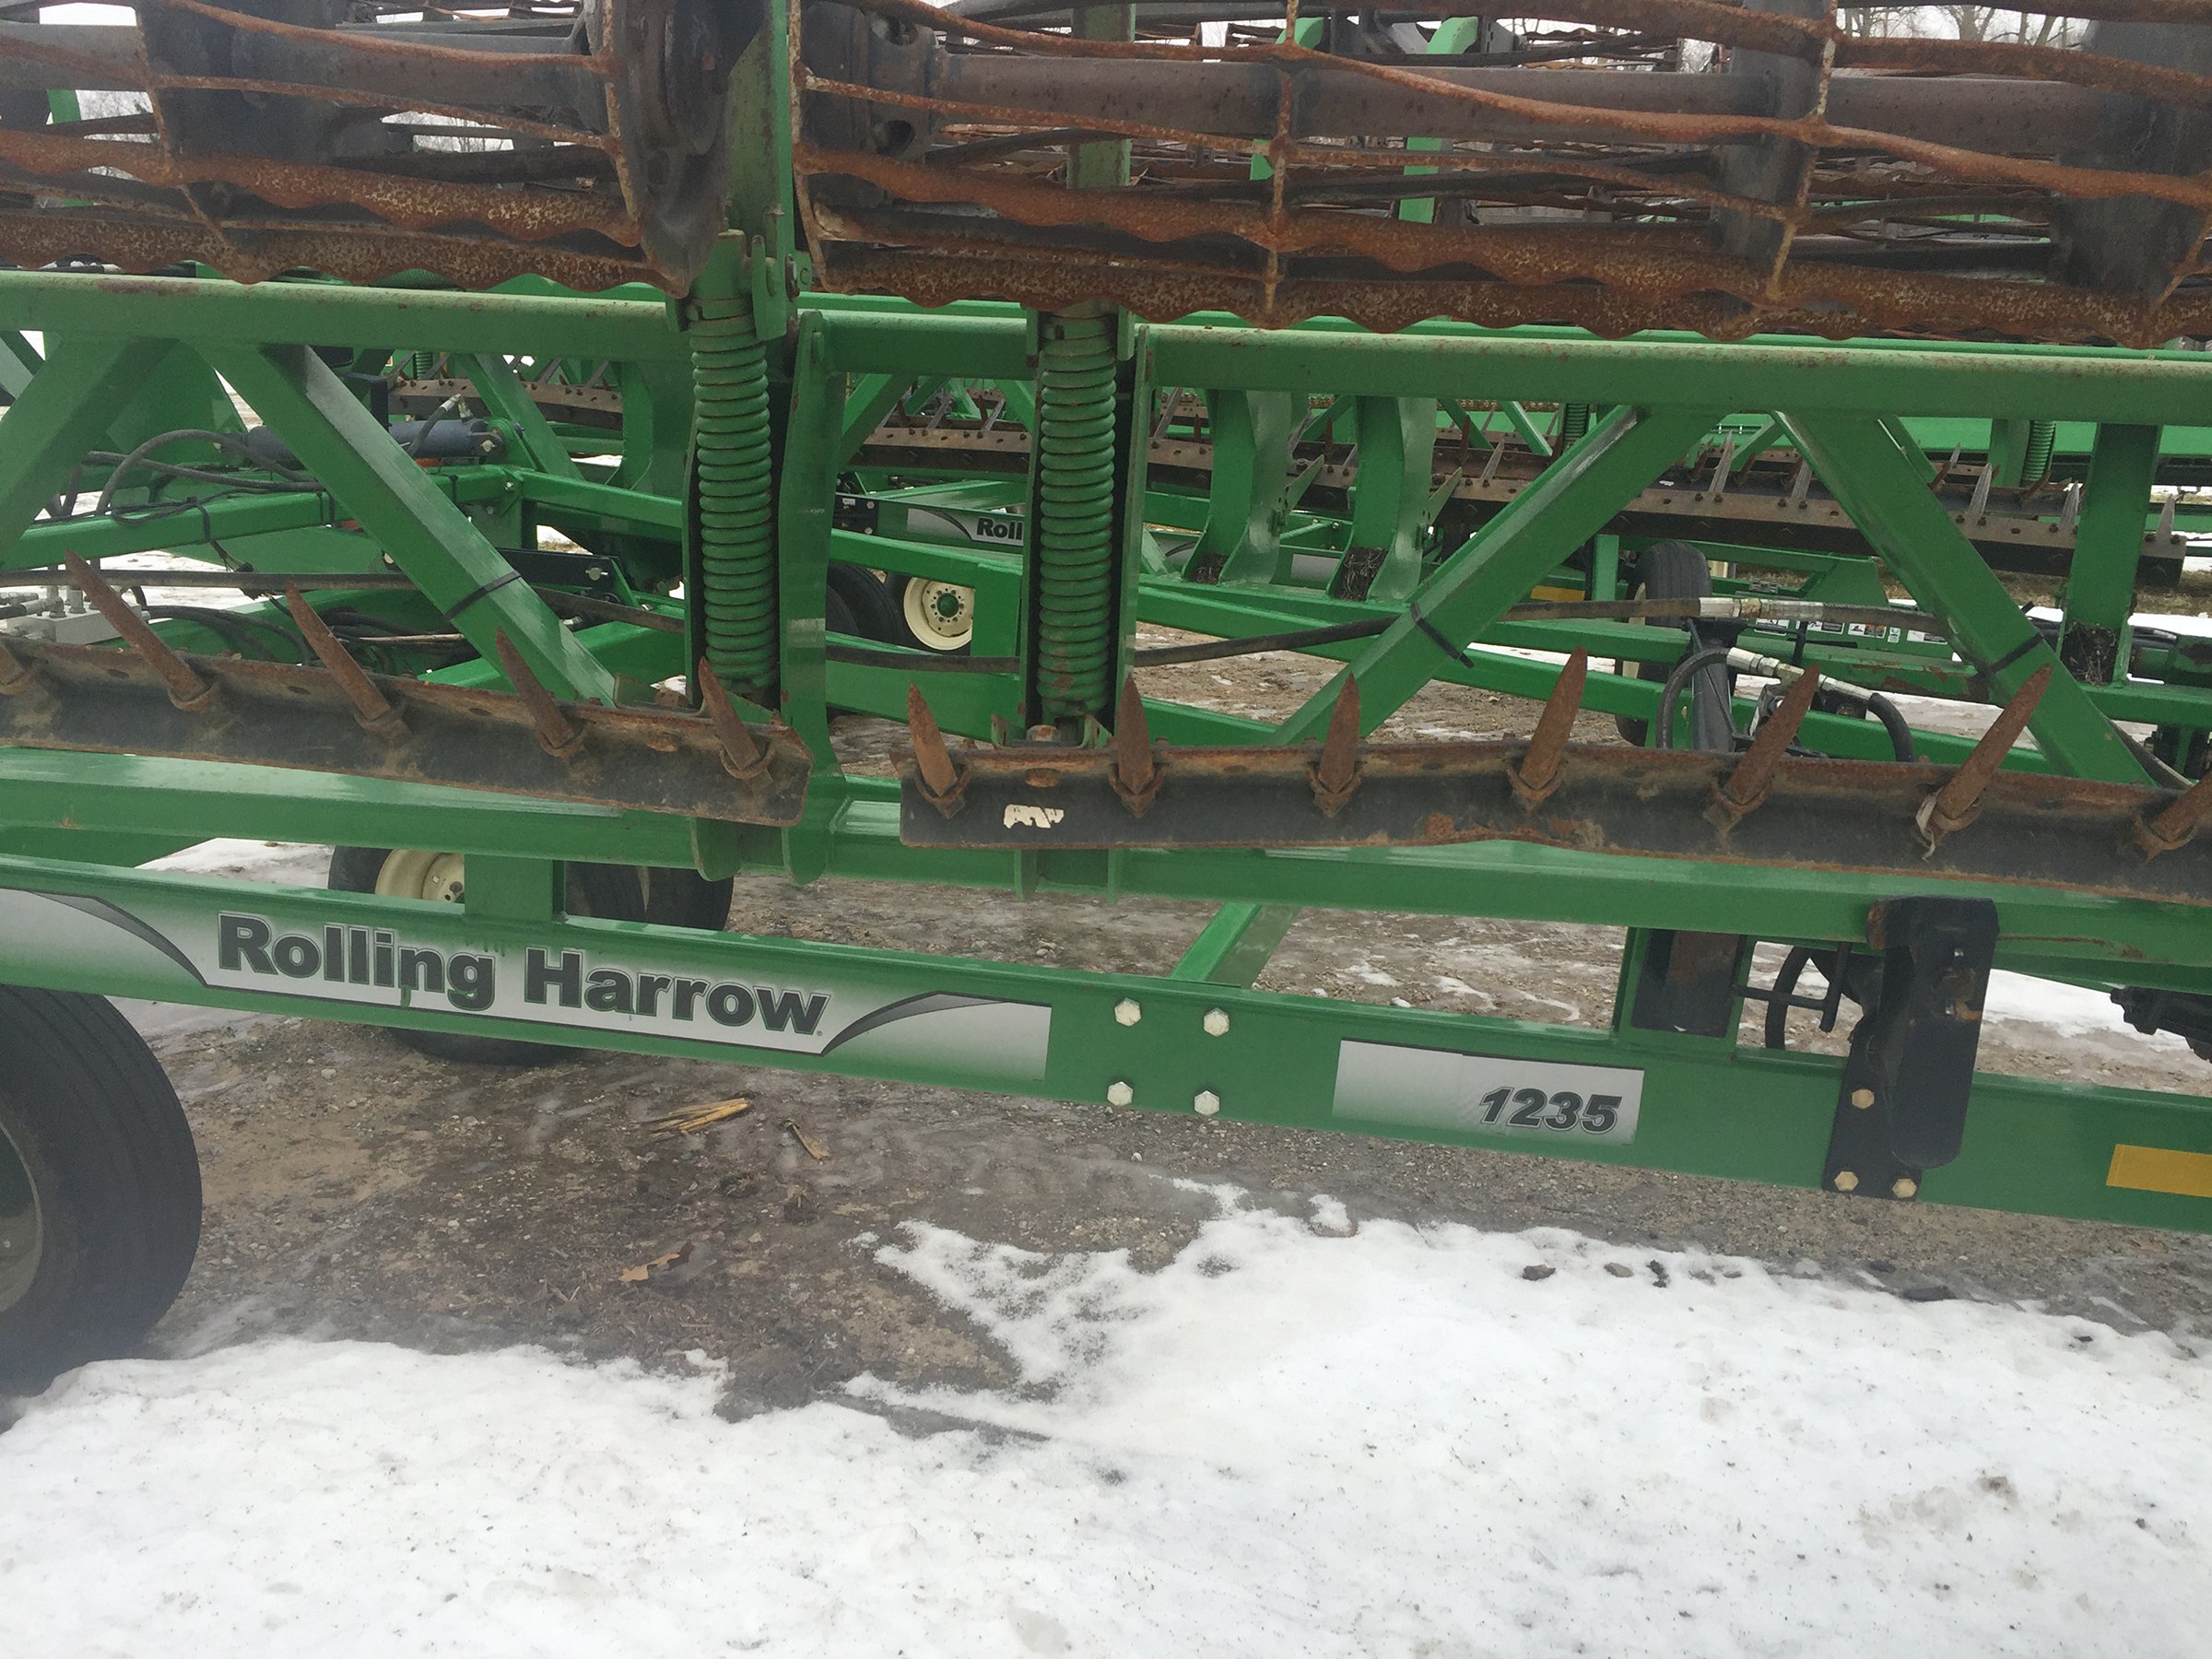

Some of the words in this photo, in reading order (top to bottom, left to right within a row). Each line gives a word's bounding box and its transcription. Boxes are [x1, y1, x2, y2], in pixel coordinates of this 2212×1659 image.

[218, 912, 495, 1010] Rolling
[524, 947, 829, 1034] Harrow
[1479, 1087, 1622, 1134] 1235
